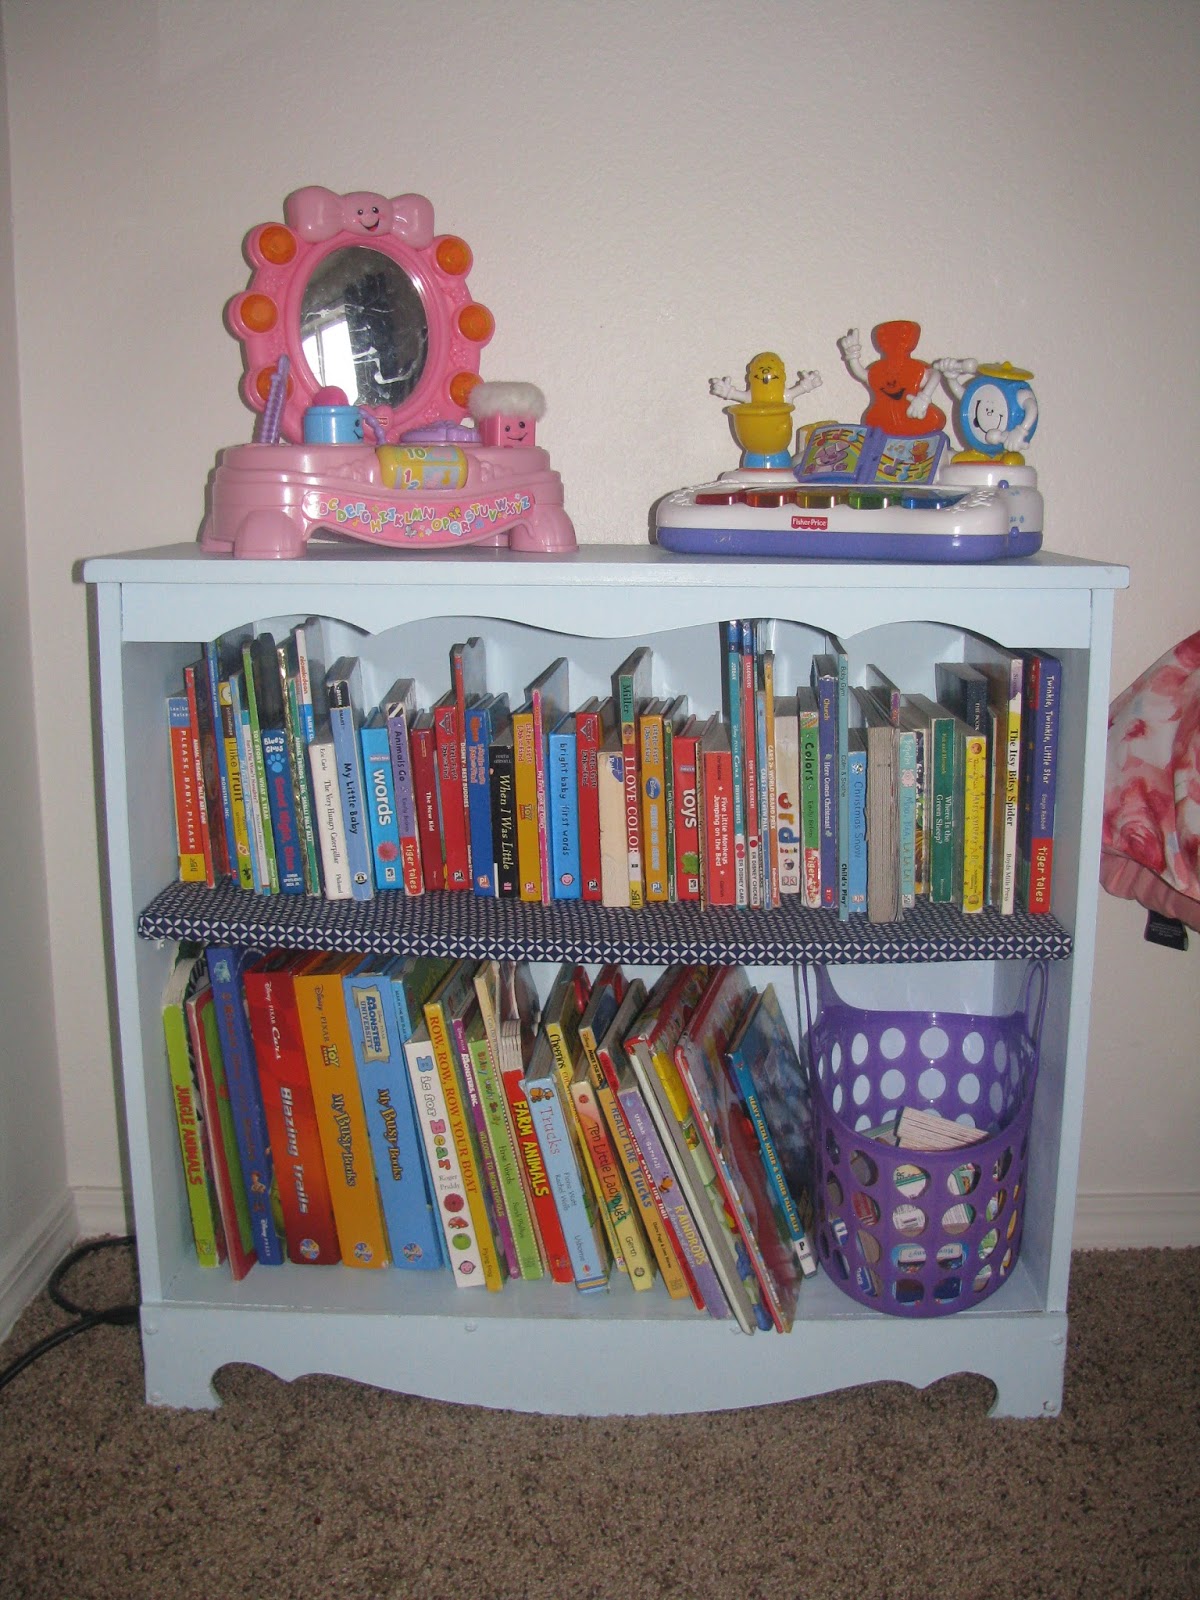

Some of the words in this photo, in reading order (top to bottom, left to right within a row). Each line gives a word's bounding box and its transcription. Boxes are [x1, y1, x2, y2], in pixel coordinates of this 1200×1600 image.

[406, 447, 426, 459] 10
[623, 685, 632, 714] Miller
[1044, 676, 1055, 708] Twinkle,
[1009, 729, 1019, 747] The
[1043, 711, 1053, 742] Twinkle,
[230, 748, 238, 768] like
[394, 731, 404, 767] Animals
[559, 743, 569, 773] bright
[805, 742, 814, 781] Colors
[1008, 750, 1019, 767] Itsy
[1042, 746, 1052, 766] Little
[342, 763, 354, 777] My
[398, 771, 406, 782] Go
[625, 766, 637, 802] LOVE
[1005, 770, 1017, 793] Bitsy
[1042, 768, 1051, 784] Star
[181, 731, 189, 773] PLEASE,
[187, 812, 195, 849] PLEASE
[231, 772, 243, 802] fruit
[275, 777, 285, 807] Good
[324, 780, 332, 792] The
[325, 793, 334, 807] Very
[346, 782, 356, 808] Little
[373, 770, 392, 826] words
[499, 775, 511, 805] When
[560, 777, 569, 799] baby
[648, 780, 657, 798] Disney
[325, 808, 336, 831] Hungry
[525, 805, 533, 820] TOY
[562, 805, 570, 826] first
[681, 788, 698, 828] toys
[713, 795, 721, 825] Jumping
[824, 798, 832, 829] Christmas!
[853, 781, 864, 829] Christmas
[935, 795, 943, 816] Green
[944, 796, 952, 820] Where
[1005, 795, 1015, 826] Spider
[350, 812, 358, 835] Baby
[501, 816, 513, 838] Was
[627, 807, 639, 854] COLOR
[715, 828, 721, 837] on
[721, 814, 729, 832] Little
[934, 818, 942, 844] Sheep?
[944, 822, 951, 831] Is
[944, 832, 952, 842] the
[329, 832, 340, 864] Caterpillar
[405, 844, 414, 866] tiger
[502, 841, 514, 870] Little
[562, 830, 570, 856] words
[752, 852, 758, 860] ER
[854, 832, 864, 858] Snow
[738, 859, 743, 868] ER
[1036, 846, 1047, 873] tiger
[408, 869, 417, 889] tales
[1035, 877, 1046, 903] tales
[264, 981, 272, 1001] Disney
[268, 1005, 276, 1024] PIXAR
[272, 1026, 282, 1060] Cars
[314, 984, 325, 1011] Disney
[320, 1016, 329, 1043] PIXAR
[327, 1044, 339, 1068] TOY
[359, 1000, 373, 1049] UNIVERSITY
[366, 995, 382, 1053] MONSTERS
[429, 1016, 444, 1049] ROW,
[416, 1055, 434, 1073] B
[550, 1033, 567, 1069] Cheerios
[421, 1076, 431, 1090] is
[436, 1052, 452, 1085] ROW,
[461, 1053, 474, 1093] MONSTERS,
[470, 1094, 478, 1107] INC.
[175, 1085, 195, 1126] JUNGLE
[331, 1094, 344, 1112] My
[377, 1089, 390, 1107] My
[424, 1093, 438, 1116] for
[445, 1087, 460, 1116] ROW
[335, 1112, 352, 1149] Busy
[381, 1107, 400, 1143] Busy
[512, 1101, 534, 1136] FARM
[540, 1106, 562, 1156] Trucks
[588, 1122, 601, 1142] Ten
[634, 1113, 646, 1135] Urban
[429, 1119, 452, 1170] Bear
[453, 1120, 469, 1157] YOUR
[612, 1107, 629, 1139] REALLY
[623, 1143, 638, 1163] LIKE
[182, 1129, 203, 1185] ANIMALS
[280, 1087, 300, 1157] Blazing
[292, 1163, 309, 1214] Trails
[388, 1146, 402, 1181] Books
[479, 1130, 490, 1159] WELCOME
[486, 1161, 494, 1170] TO
[593, 1144, 612, 1172] Little
[748, 1095, 761, 1119] HEAVY
[756, 1120, 768, 1141] METAL
[764, 1142, 776, 1165] MATER
[775, 1174, 787, 1196] OTHER
[783, 1197, 793, 1212] TALL
[789, 1213, 800, 1233] TALES
[342, 1152, 357, 1187] Books
[462, 1160, 478, 1194] BOAT
[522, 1141, 550, 1197] ANIMALS
[564, 1172, 573, 1189] Fiona
[569, 1191, 577, 1207] Watt
[603, 1175, 628, 1221] Ladybugs
[674, 1205, 705, 1265] RAINDROPS
